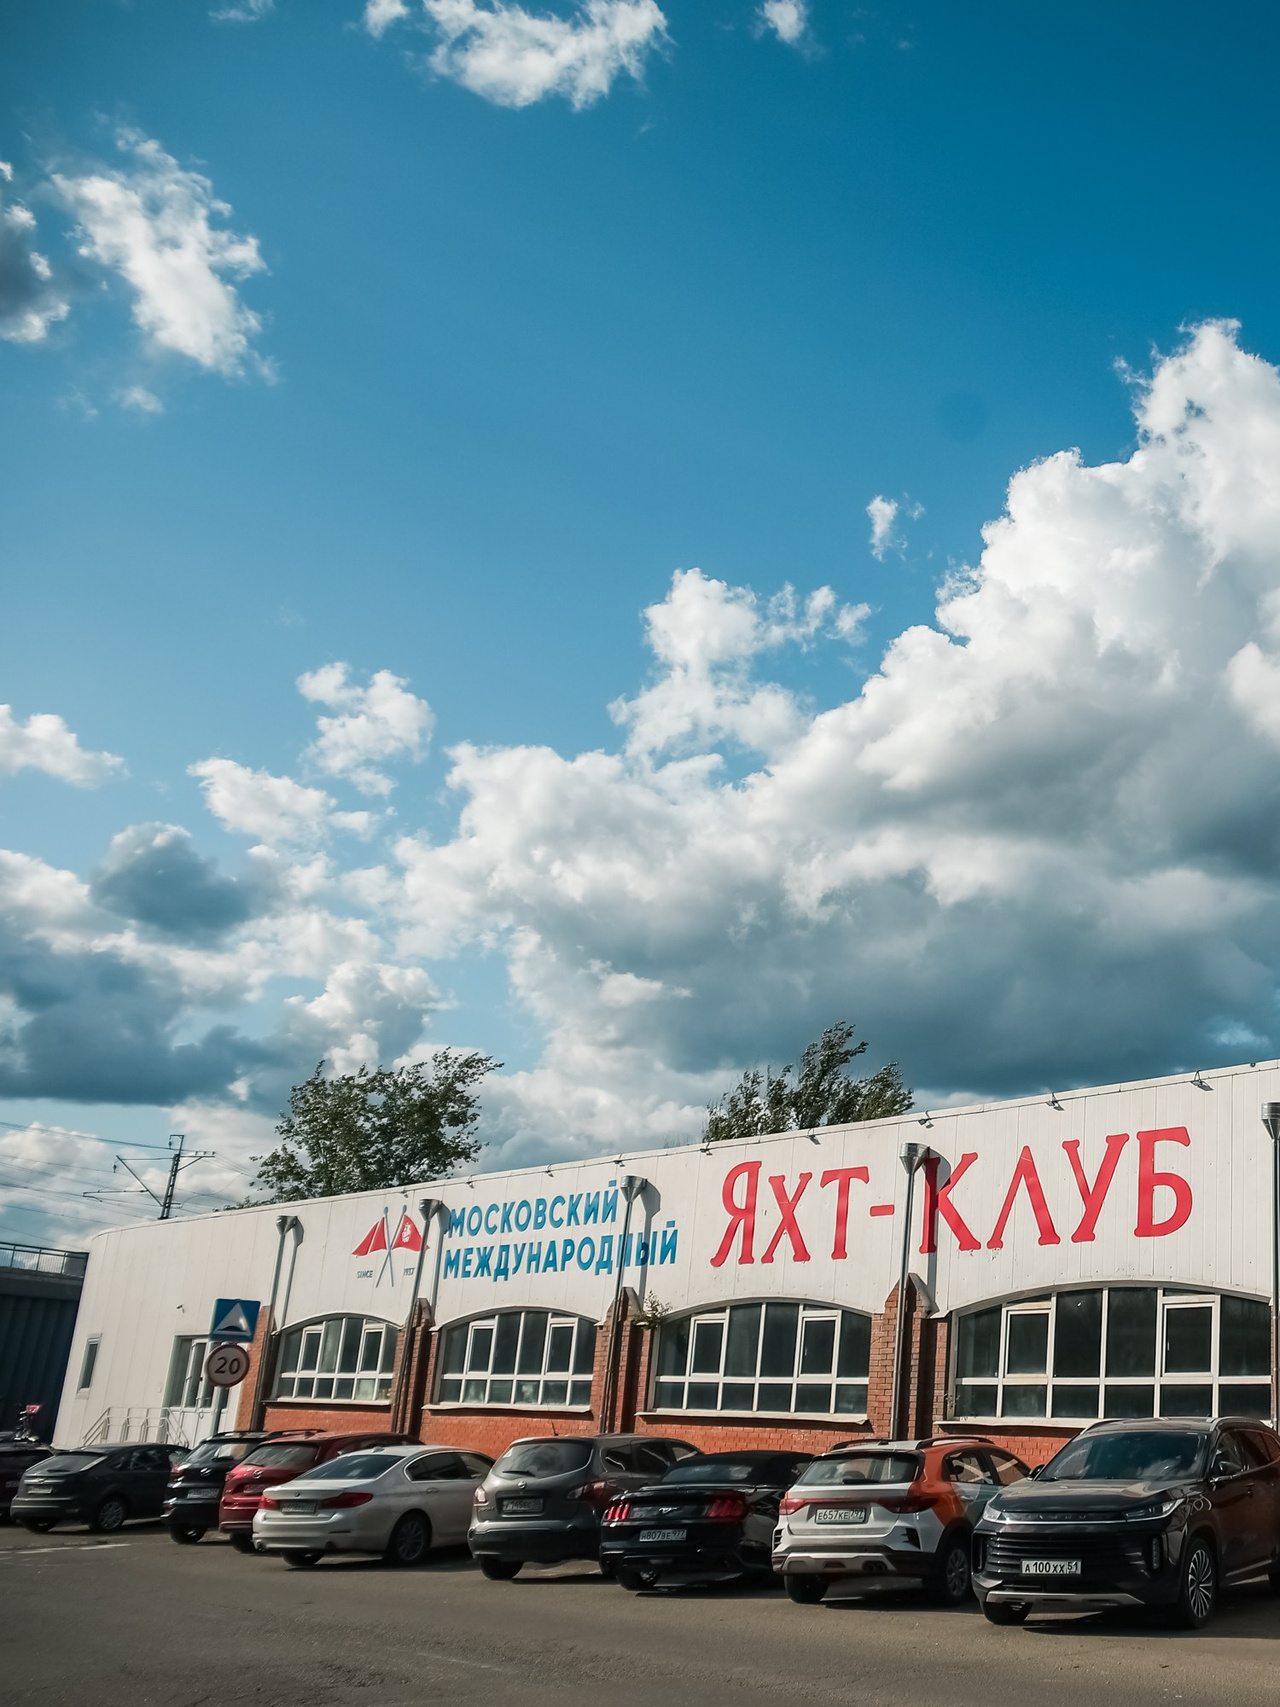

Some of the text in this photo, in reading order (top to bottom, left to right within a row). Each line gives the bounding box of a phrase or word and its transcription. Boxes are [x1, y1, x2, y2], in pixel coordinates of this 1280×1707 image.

[448, 1179, 619, 1239] МОСКОВСКИЙ
[709, 1125, 1194, 1268] ЯХТ-КЛУБ
[443, 1220, 679, 1283] МЕЖДУНАРОДНЫЙ
[214, 1356, 241, 1375] 20
